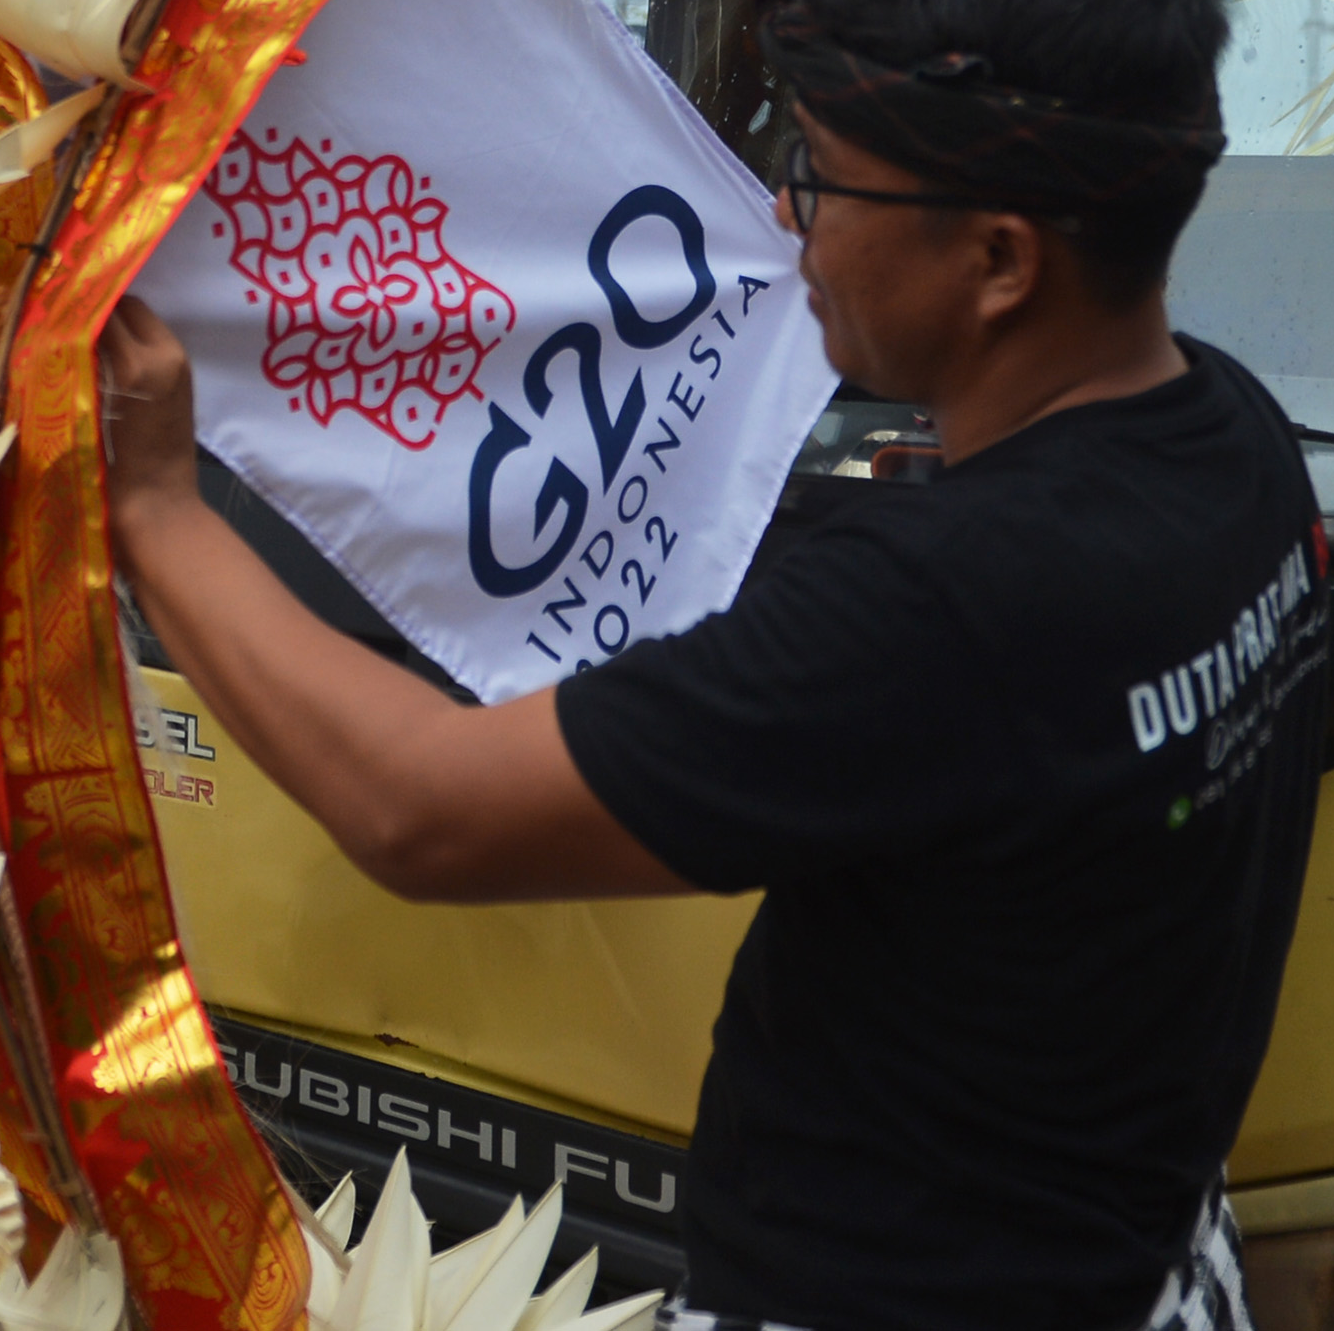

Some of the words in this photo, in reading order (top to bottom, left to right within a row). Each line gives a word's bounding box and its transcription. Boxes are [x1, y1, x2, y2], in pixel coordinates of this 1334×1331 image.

[468, 184, 717, 599] G20
[526, 274, 771, 664] INDONESIA
[1127, 638, 1237, 754] DUTA
